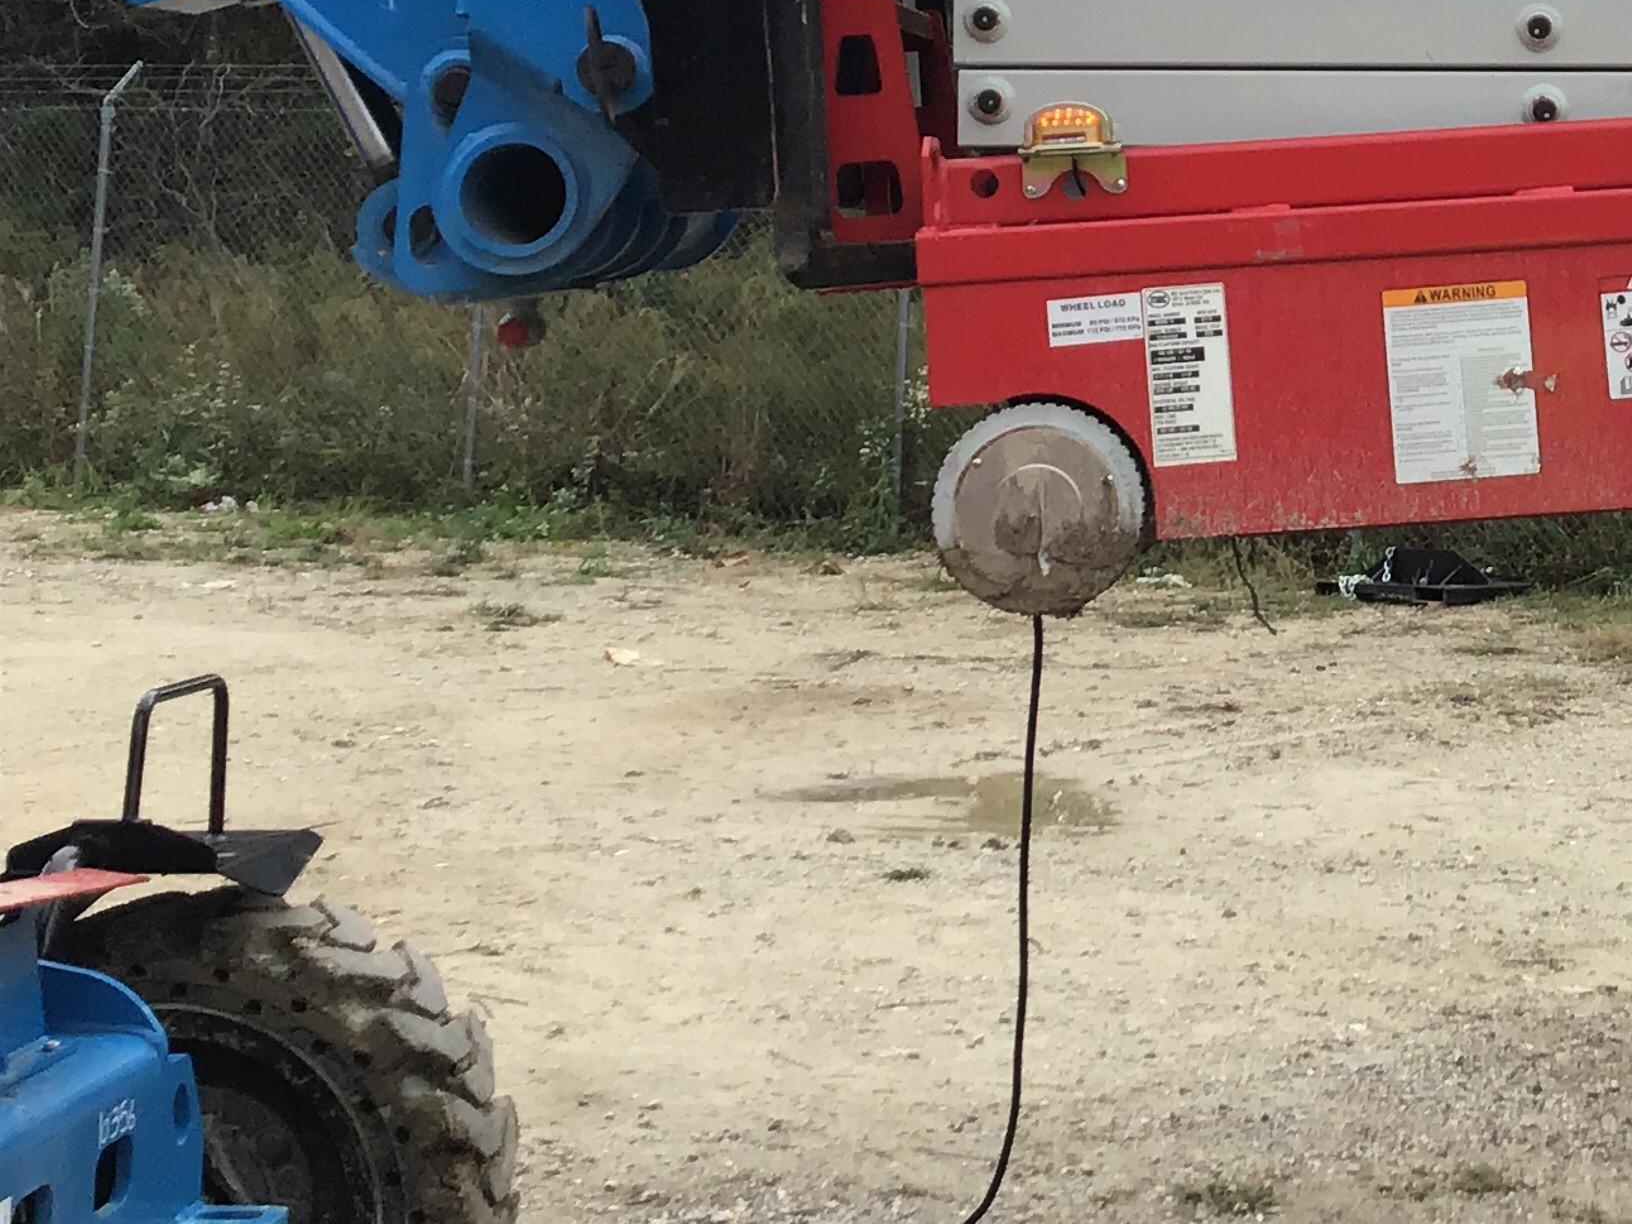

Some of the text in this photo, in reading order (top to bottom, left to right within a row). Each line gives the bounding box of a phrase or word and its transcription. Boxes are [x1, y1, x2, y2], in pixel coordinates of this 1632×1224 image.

[1428, 284, 1497, 302] WARNING
[1060, 298, 1126, 313] WHEEL LOAD
